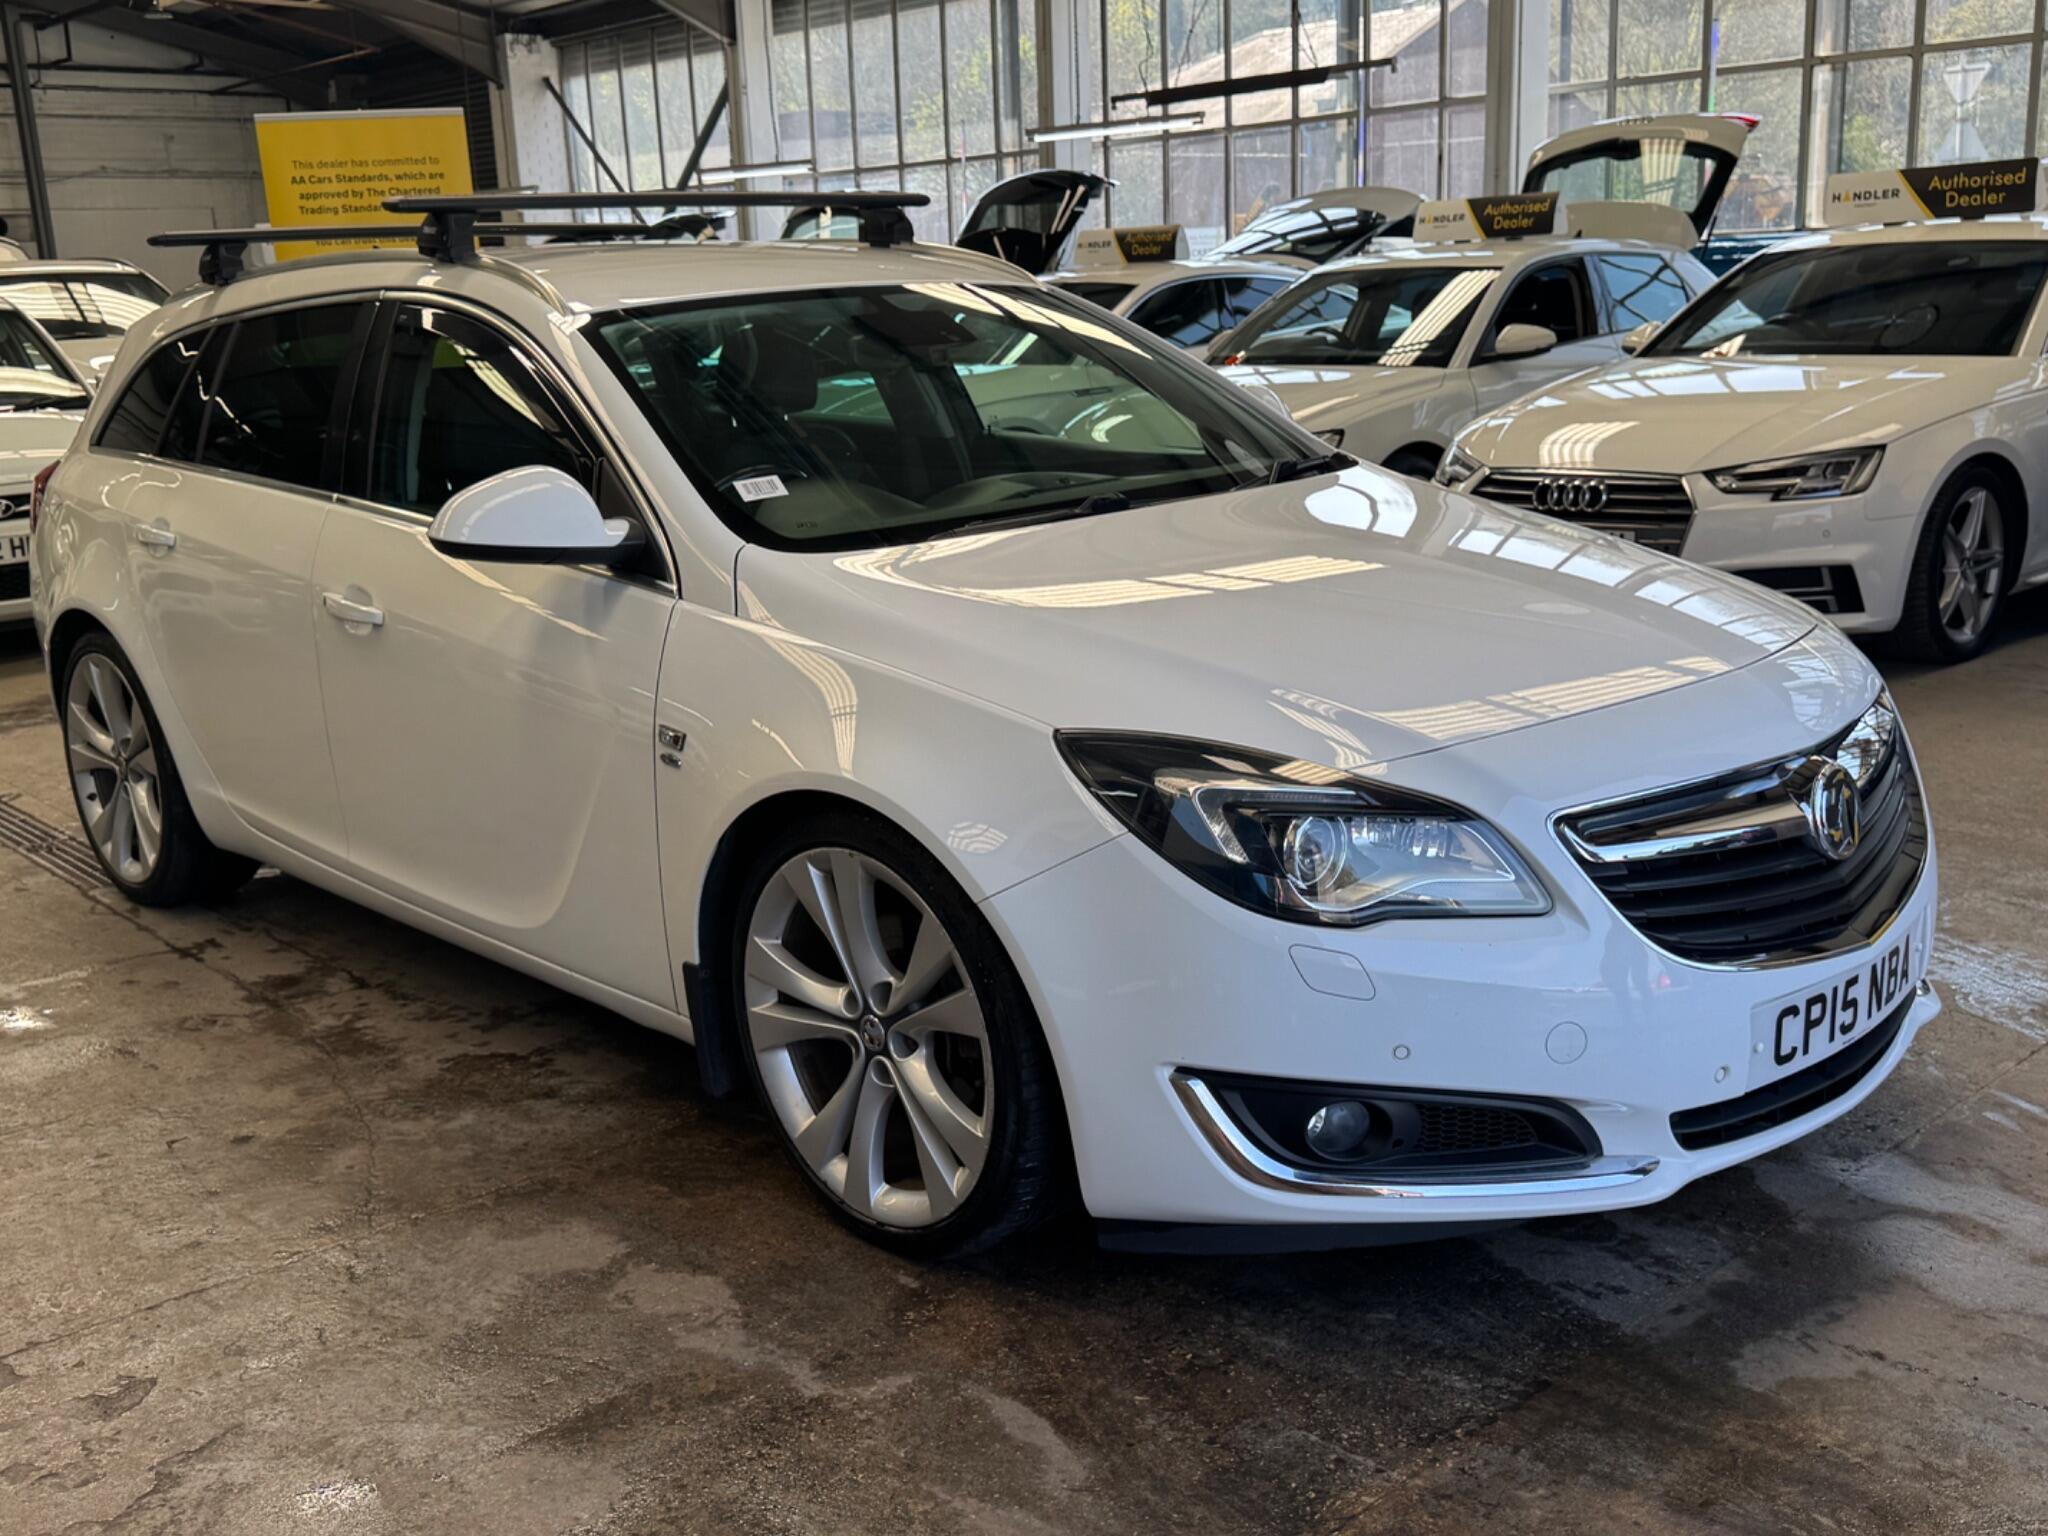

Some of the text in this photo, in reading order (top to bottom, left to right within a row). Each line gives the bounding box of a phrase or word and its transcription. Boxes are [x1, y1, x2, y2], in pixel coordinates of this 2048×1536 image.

[291, 155, 440, 170] This dealer has committed to
[291, 171, 444, 185] AA Cars Standards, which are
[1929, 167, 2027, 192] Authorised
[299, 185, 441, 201] approved by The Chartered
[1832, 187, 1900, 203] HANDLER
[1945, 190, 2006, 208] Dealer
[298, 203, 383, 216] Trading Standar
[1484, 198, 1550, 217] Authorised
[1418, 212, 1466, 225] HANDLER
[1493, 215, 1534, 230] Dealer
[1773, 934, 1911, 1067] CP15 NBA
